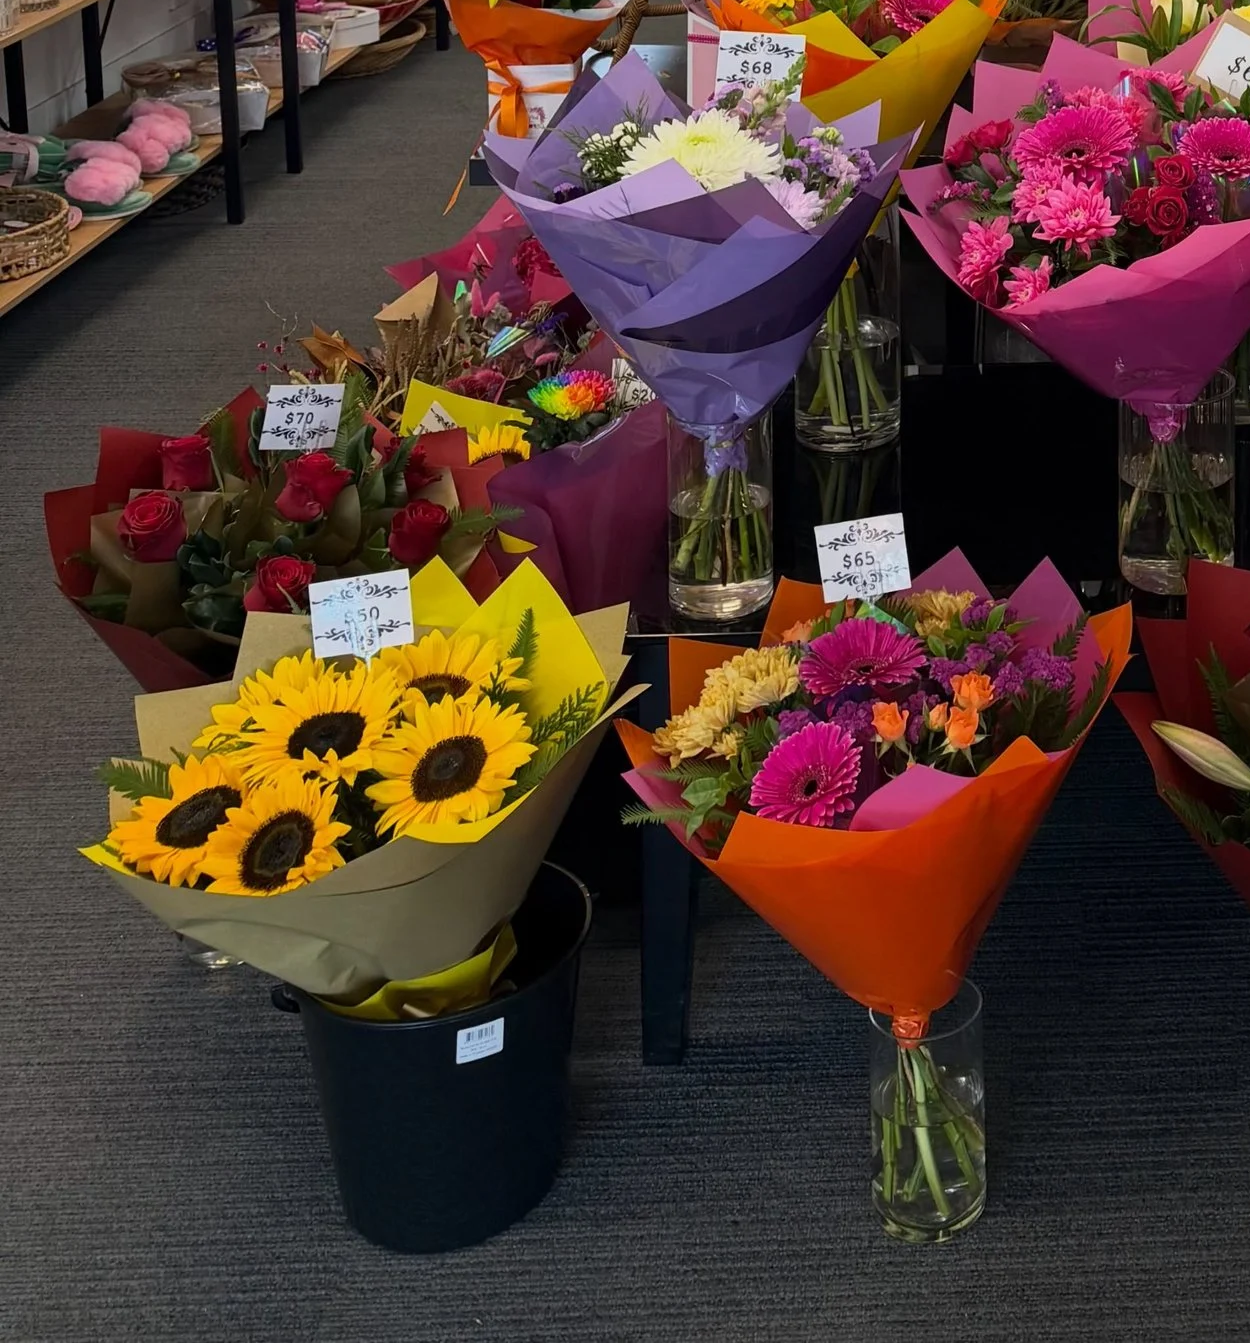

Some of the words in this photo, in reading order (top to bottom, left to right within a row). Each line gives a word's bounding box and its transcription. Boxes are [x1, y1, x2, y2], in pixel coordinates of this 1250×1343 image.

[739, 59, 773, 76] $68
[284, 411, 314, 425] $70
[842, 550, 876, 569] $65
[343, 605, 381, 625] $50
